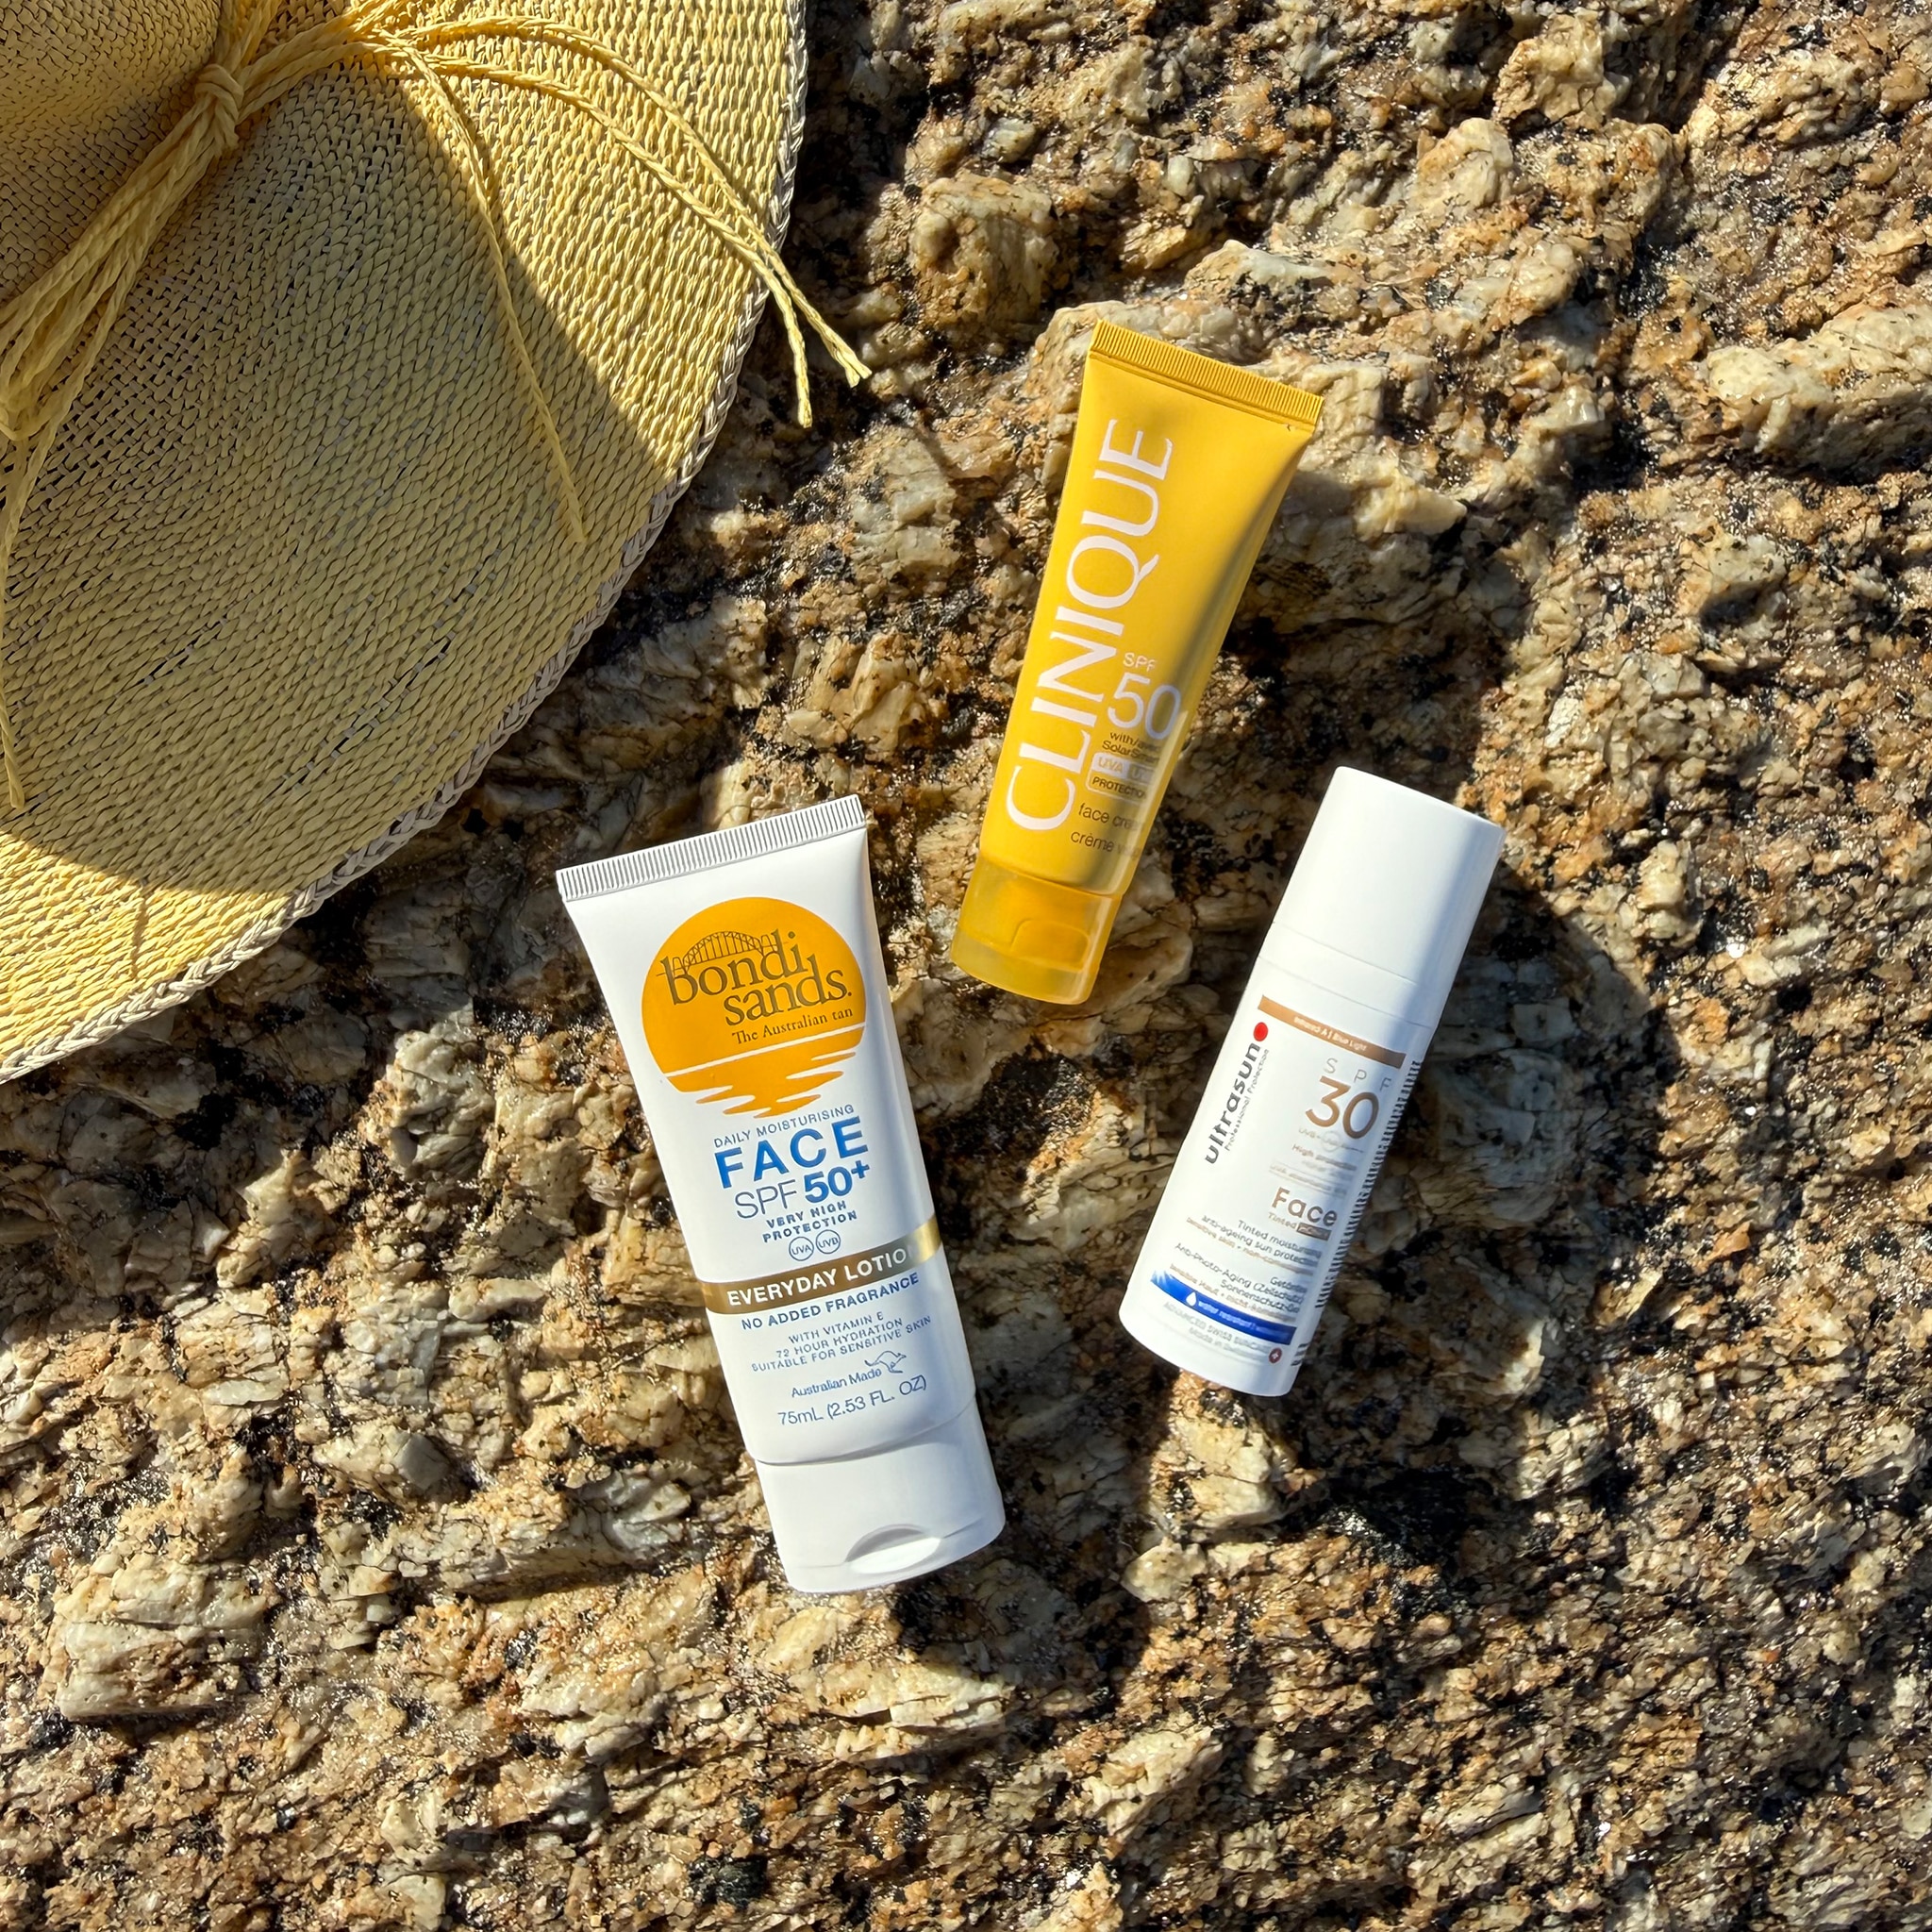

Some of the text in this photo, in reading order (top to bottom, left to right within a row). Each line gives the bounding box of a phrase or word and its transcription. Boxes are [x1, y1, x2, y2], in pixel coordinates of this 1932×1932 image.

[1006, 418, 1174, 830] CLINIQUE
[1123, 652, 1157, 673] SPF
[1107, 672, 1182, 740] 50
[1097, 756, 1124, 774] UVA
[1091, 776, 1146, 799] PROTECTIO
[1078, 802, 1109, 824] face
[660, 928, 808, 1006] bondi
[732, 1008, 853, 1044] The Australian tan
[1205, 1042, 1261, 1164] ultrasun
[1306, 1075, 1379, 1140] 30
[713, 1104, 855, 1148] DAILY MOISTURISING
[714, 1116, 869, 1189] FACE
[735, 1159, 870, 1219] SPF 50+
[1272, 1187, 1338, 1226] Face
[762, 1210, 858, 1243] PROTECTION
[766, 1210, 804, 1228] VERY
[1239, 1220, 1268, 1241] Tinted
[1268, 1211, 1298, 1230] Tinted
[791, 1236, 839, 1256] UVA UVB
[1256, 1241, 1273, 1254] sun
[726, 1268, 837, 1307] EVERYDAY
[741, 1271, 920, 1330] NO ADDED FRAGRANCE
[751, 1315, 932, 1372] SUITABLE FOR SENSITIVE SKIN
[775, 1317, 903, 1359] 72 HOUR HYDRATION
[788, 1310, 884, 1344] WITH VITAMIN E
[777, 1374, 927, 1425] 75mL (2.53 FL. OZ)
[791, 1367, 882, 1398] Australian Made
